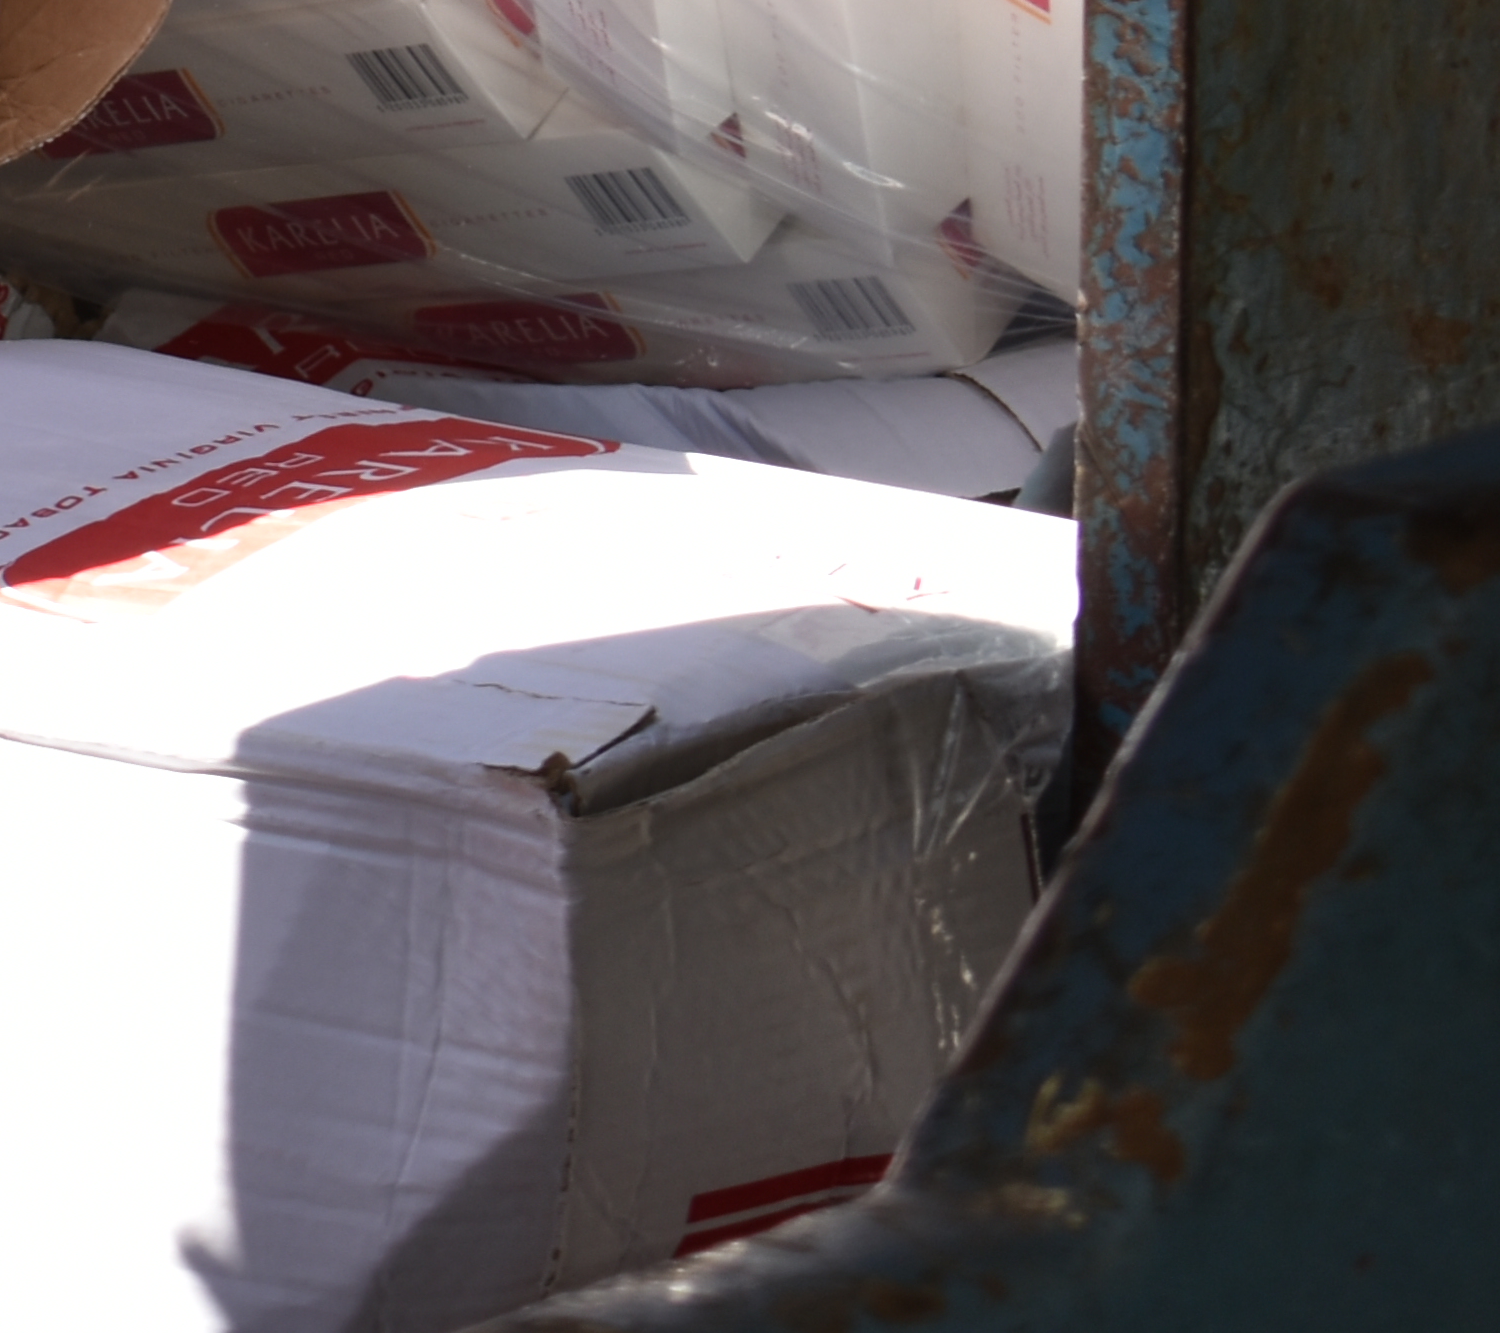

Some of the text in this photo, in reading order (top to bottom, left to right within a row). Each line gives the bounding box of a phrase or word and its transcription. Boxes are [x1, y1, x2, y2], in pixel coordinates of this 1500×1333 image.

[450, 311, 606, 349] ARELIA
[112, 421, 278, 482] VIRGINIA
[170, 449, 324, 509] RED
